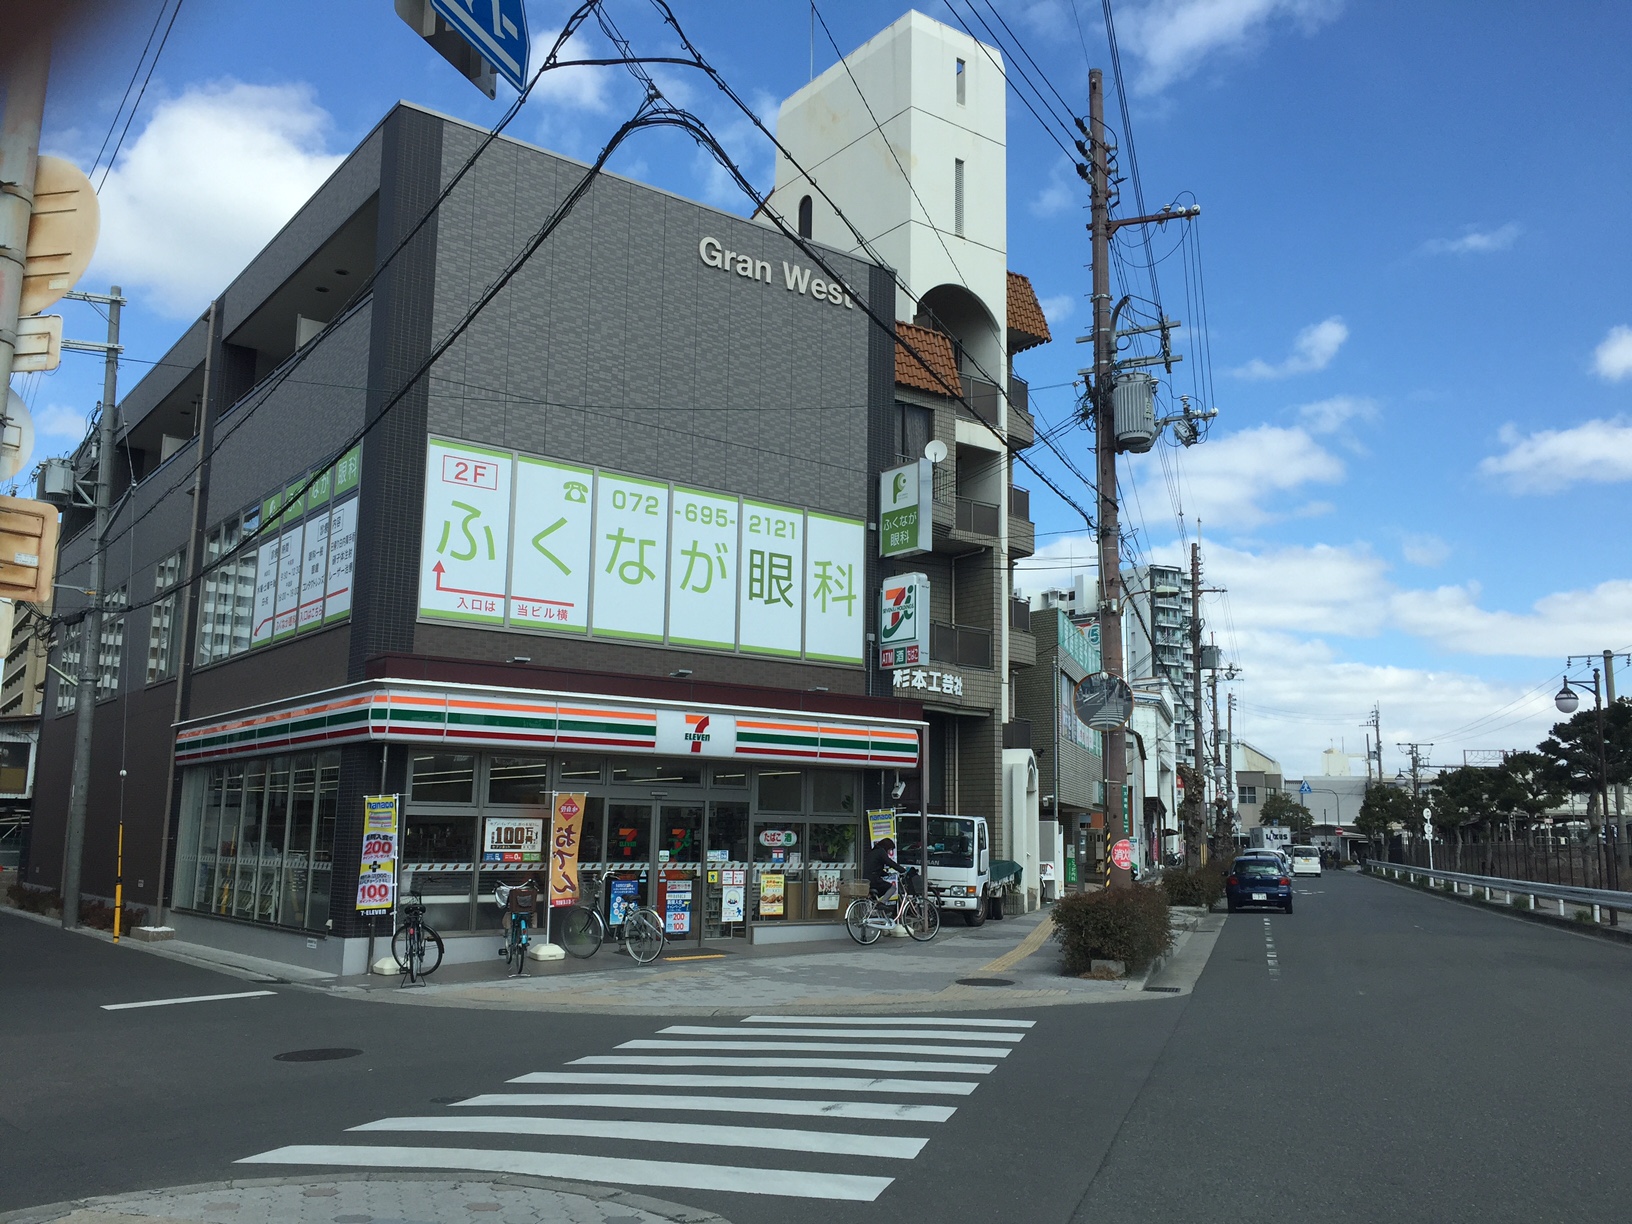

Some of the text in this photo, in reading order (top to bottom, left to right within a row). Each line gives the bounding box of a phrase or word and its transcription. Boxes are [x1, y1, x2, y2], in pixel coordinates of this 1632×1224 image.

[699, 236, 772, 284] Gran
[454, 462, 488, 484] 2F
[612, 489, 797, 540] 072-695-2121
[883, 511, 917, 531] ふくなが
[890, 529, 910, 547] 眼科
[436, 499, 858, 617] ふくなが眼科
[517, 604, 569, 622] 当ビル横
[882, 651, 893, 665] ATM
[896, 649, 905, 664] 酒
[893, 668, 963, 697] 杉本工芸社
[763, 832, 782, 843] たばこ
[363, 841, 393, 857] 200
[360, 884, 389, 899] 100
[672, 913, 685, 921] 200
